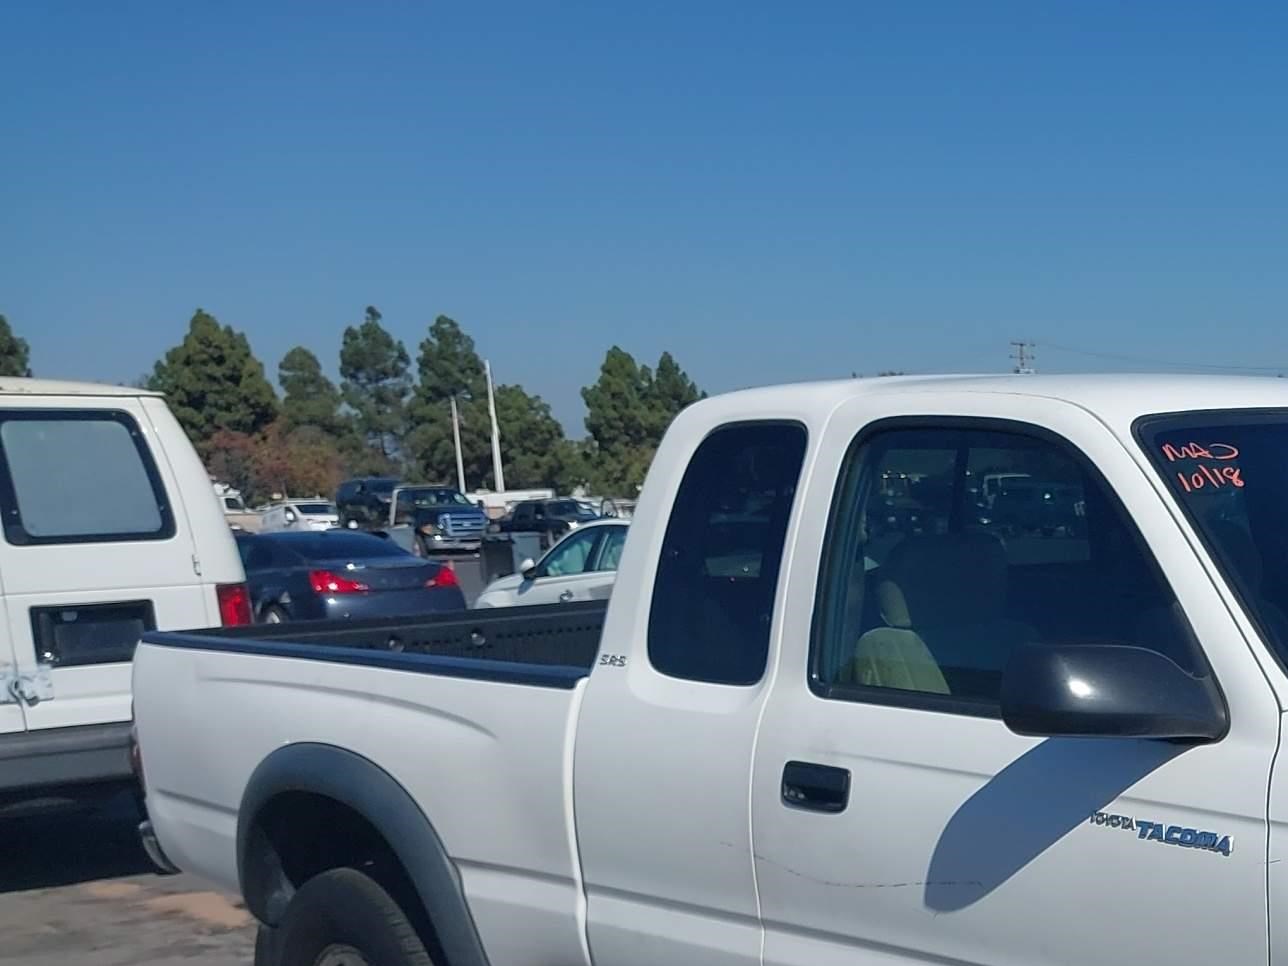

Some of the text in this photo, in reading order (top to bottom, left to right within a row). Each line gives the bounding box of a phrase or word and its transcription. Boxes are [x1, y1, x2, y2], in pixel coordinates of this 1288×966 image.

[1177, 464, 1245, 492] 10/18
[1090, 810, 1234, 857] TOYOTA TACOMA
